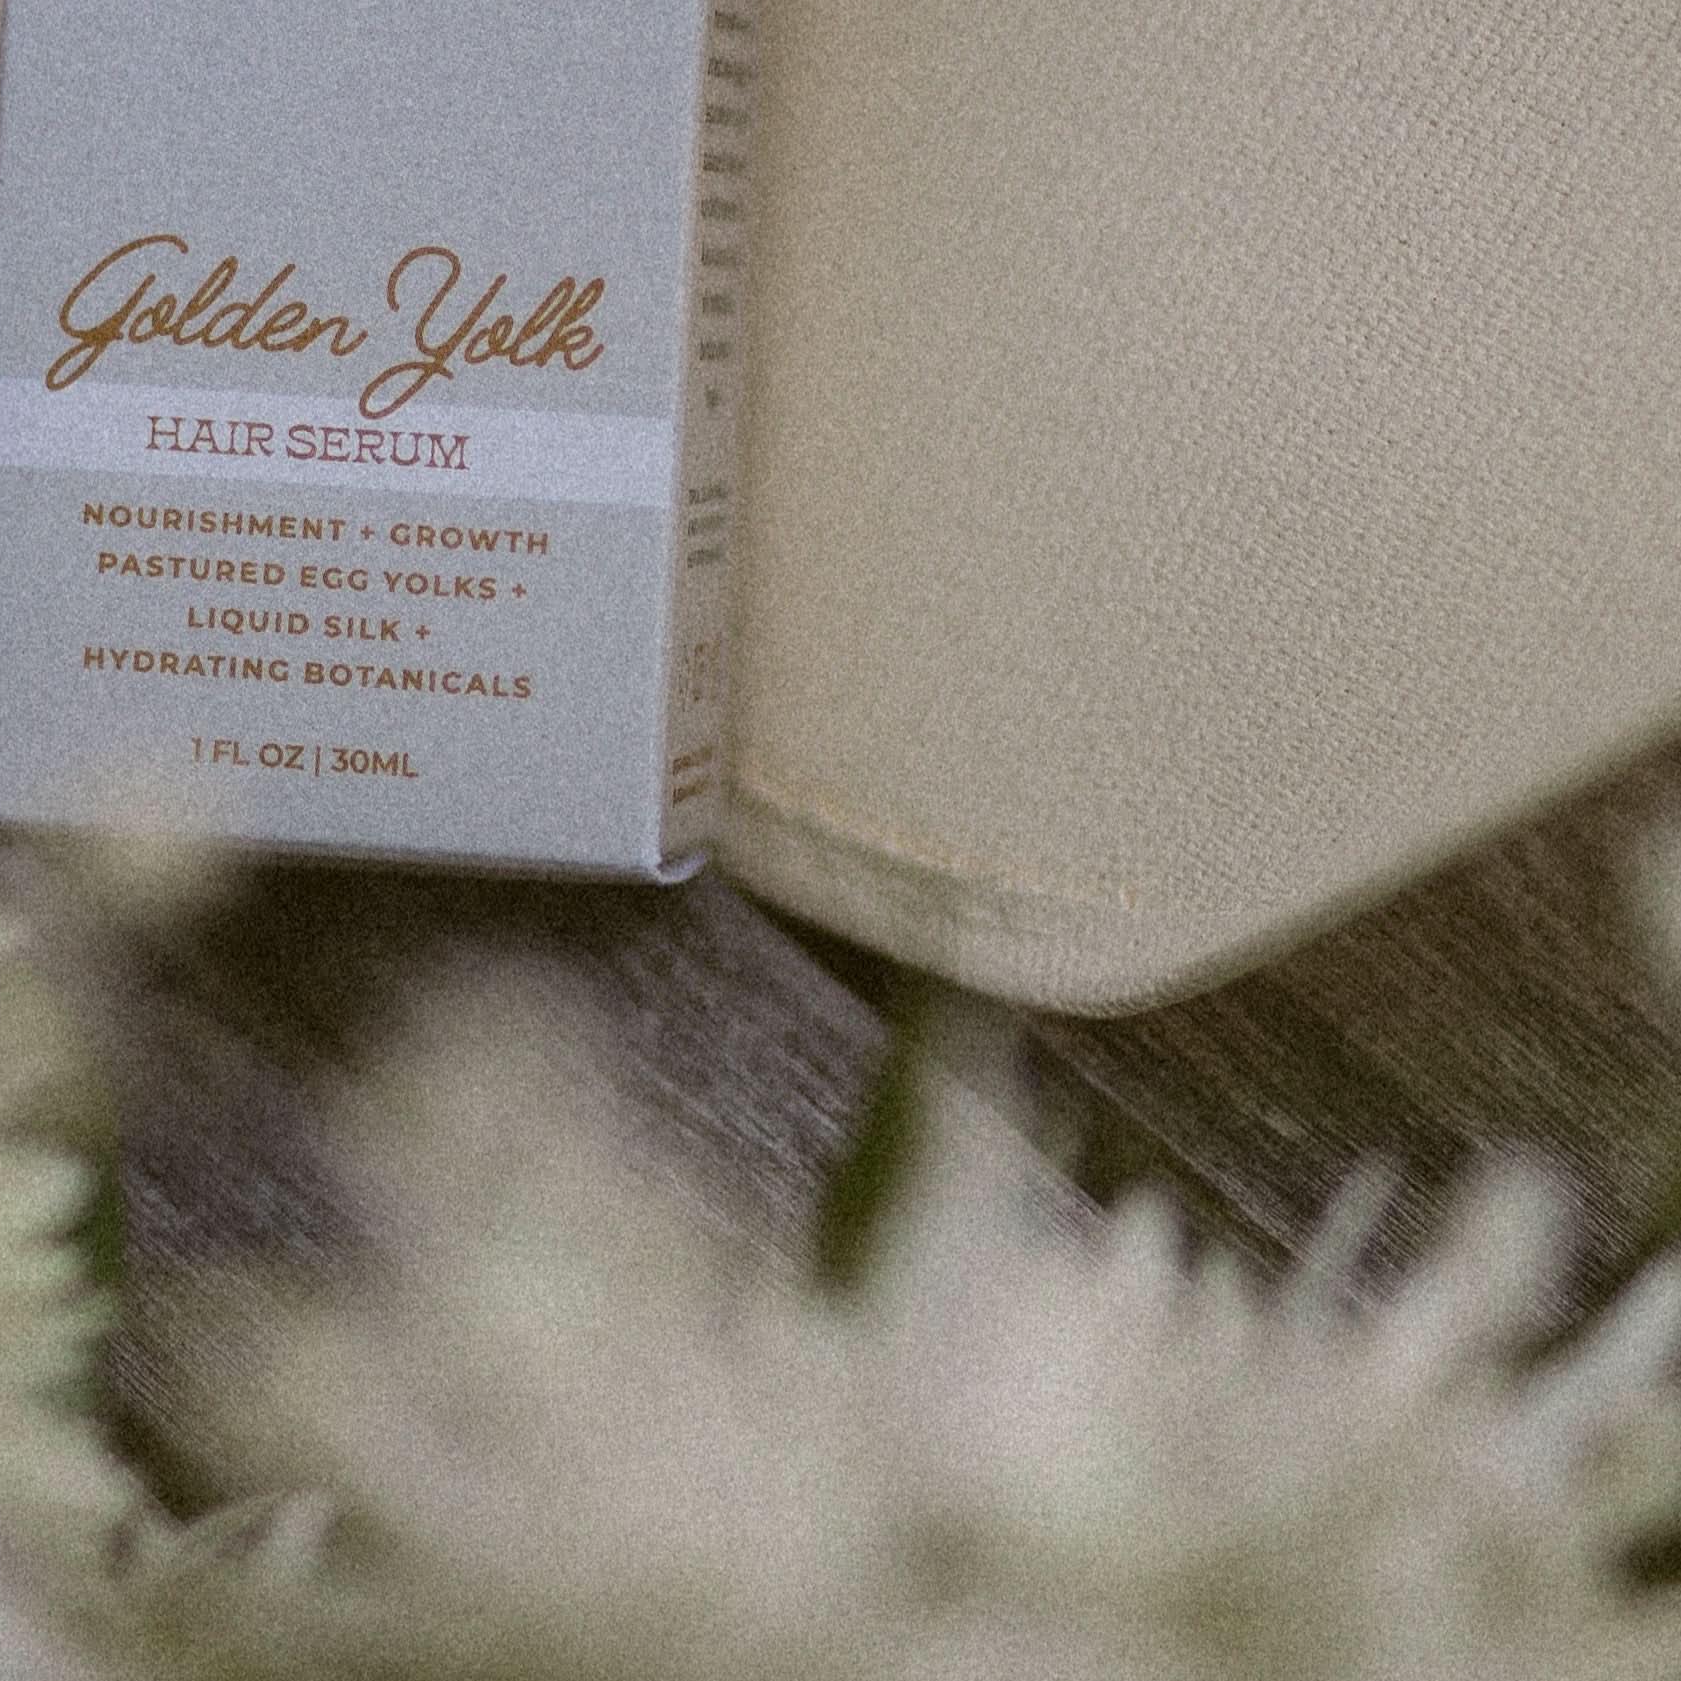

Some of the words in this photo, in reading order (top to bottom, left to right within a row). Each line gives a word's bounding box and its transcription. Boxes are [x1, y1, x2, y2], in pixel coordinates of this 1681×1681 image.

[45, 234, 367, 391] Golden
[359, 246, 605, 420] Yolk
[146, 416, 274, 457] HAIR
[286, 425, 471, 470] SERUM
[82, 503, 346, 541] NOURISHMENT
[390, 523, 550, 555] GROWTH
[98, 552, 286, 585] PASTURED
[300, 565, 368, 591] EGG
[383, 571, 497, 600] YOLKS
[187, 606, 310, 636] LIQUID
[323, 615, 401, 642] SILK
[82, 646, 290, 682] HYDRATING
[304, 662, 533, 699] BOTANICALS
[213, 739, 249, 768] FL
[258, 742, 305, 770] OZ
[330, 747, 419, 779] 30ML
